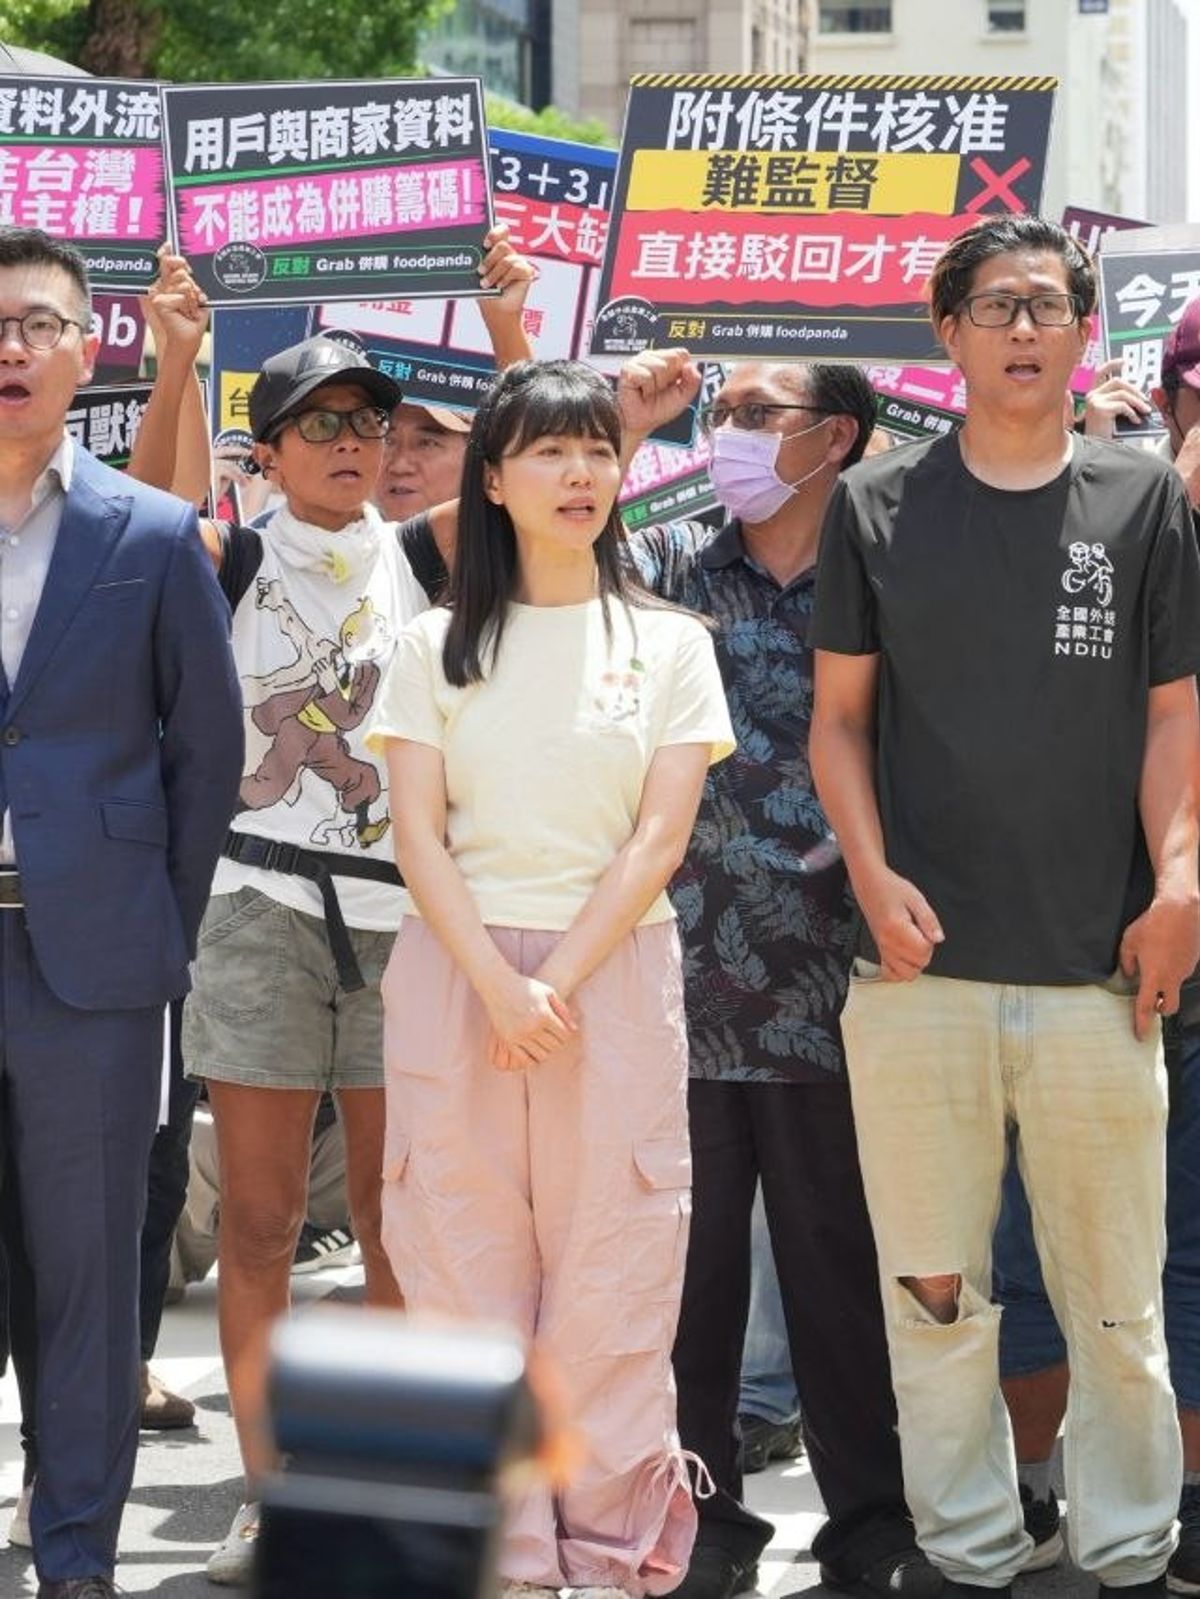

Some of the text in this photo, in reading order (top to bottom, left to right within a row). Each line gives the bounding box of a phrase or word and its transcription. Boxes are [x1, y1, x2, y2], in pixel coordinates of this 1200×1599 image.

[184, 94, 474, 173] 用戶與商家資料
[665, 91, 1010, 155] 附條件核准
[700, 154, 879, 211] 難監督
[272, 256, 310, 276] 反對
[316, 256, 354, 273] Grab
[393, 252, 472, 270] foodpanda
[631, 231, 945, 284] 直接駁回才有
[668, 320, 848, 341] 反對 Grab 併購 foodpanda
[377, 359, 412, 382] 反對
[416, 368, 447, 387] Grab
[886, 403, 921, 425] Grab
